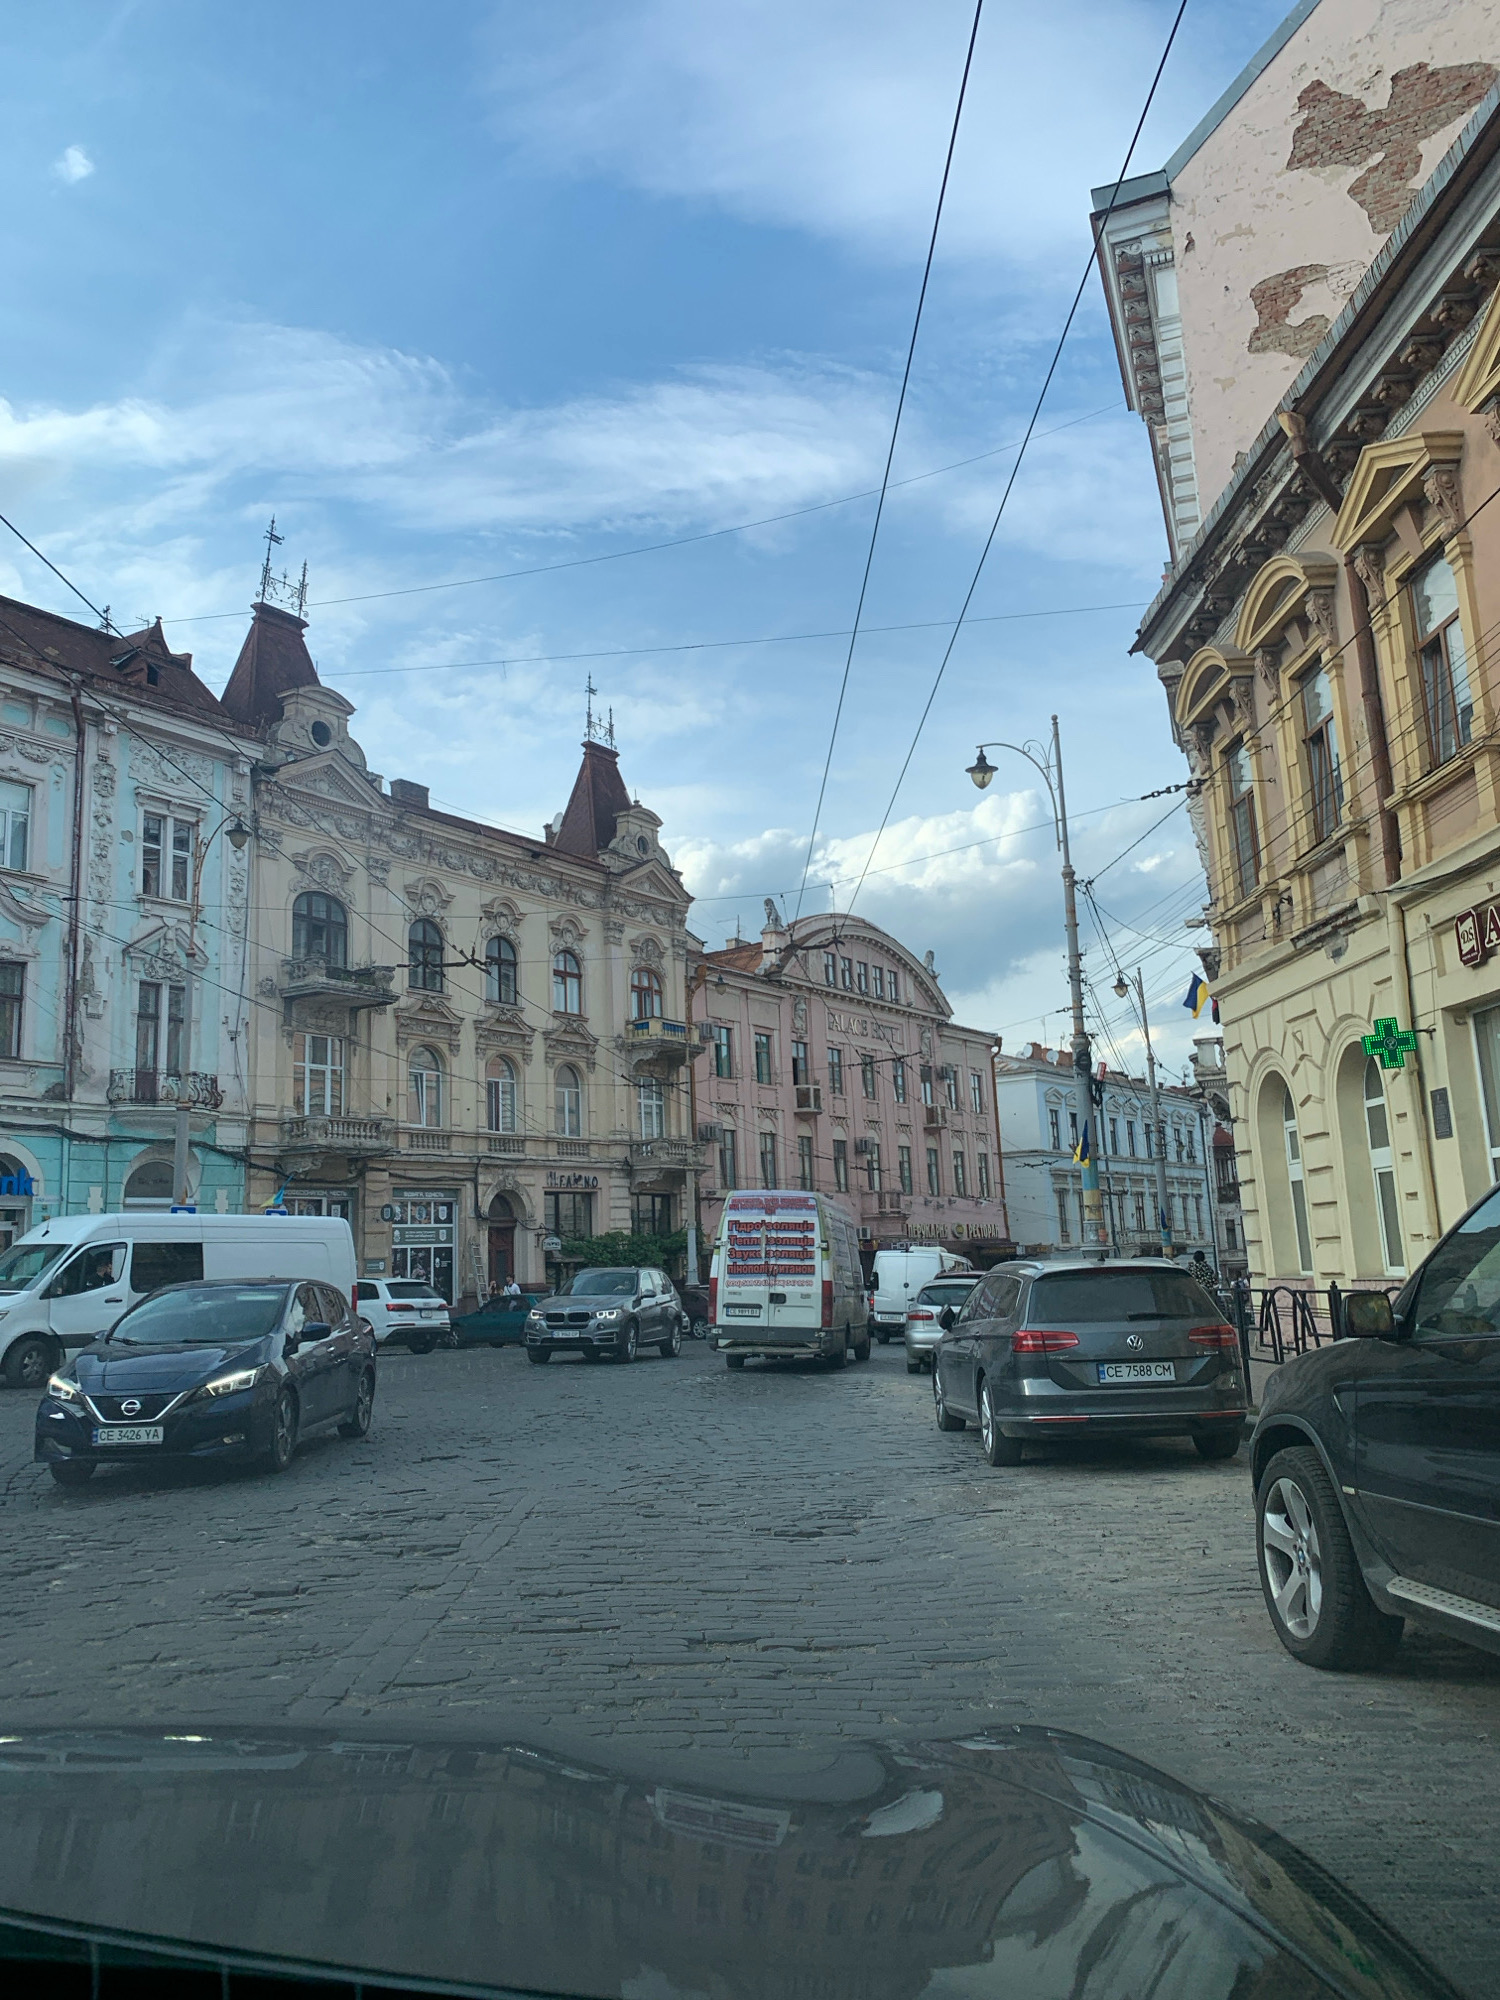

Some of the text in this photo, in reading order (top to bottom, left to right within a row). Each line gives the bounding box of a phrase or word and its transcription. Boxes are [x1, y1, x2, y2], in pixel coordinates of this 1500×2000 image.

[907, 1223, 999, 1239] ПЕРУКАРНЯ РЕСТОРАН
[728, 1248, 815, 1261] Звукозоляція
[1106, 1366, 1123, 1378] CE
[1125, 1365, 1152, 1377] 7588
[1154, 1364, 1171, 1376] CM
[100, 1429, 159, 1441] CE 3426 YA
